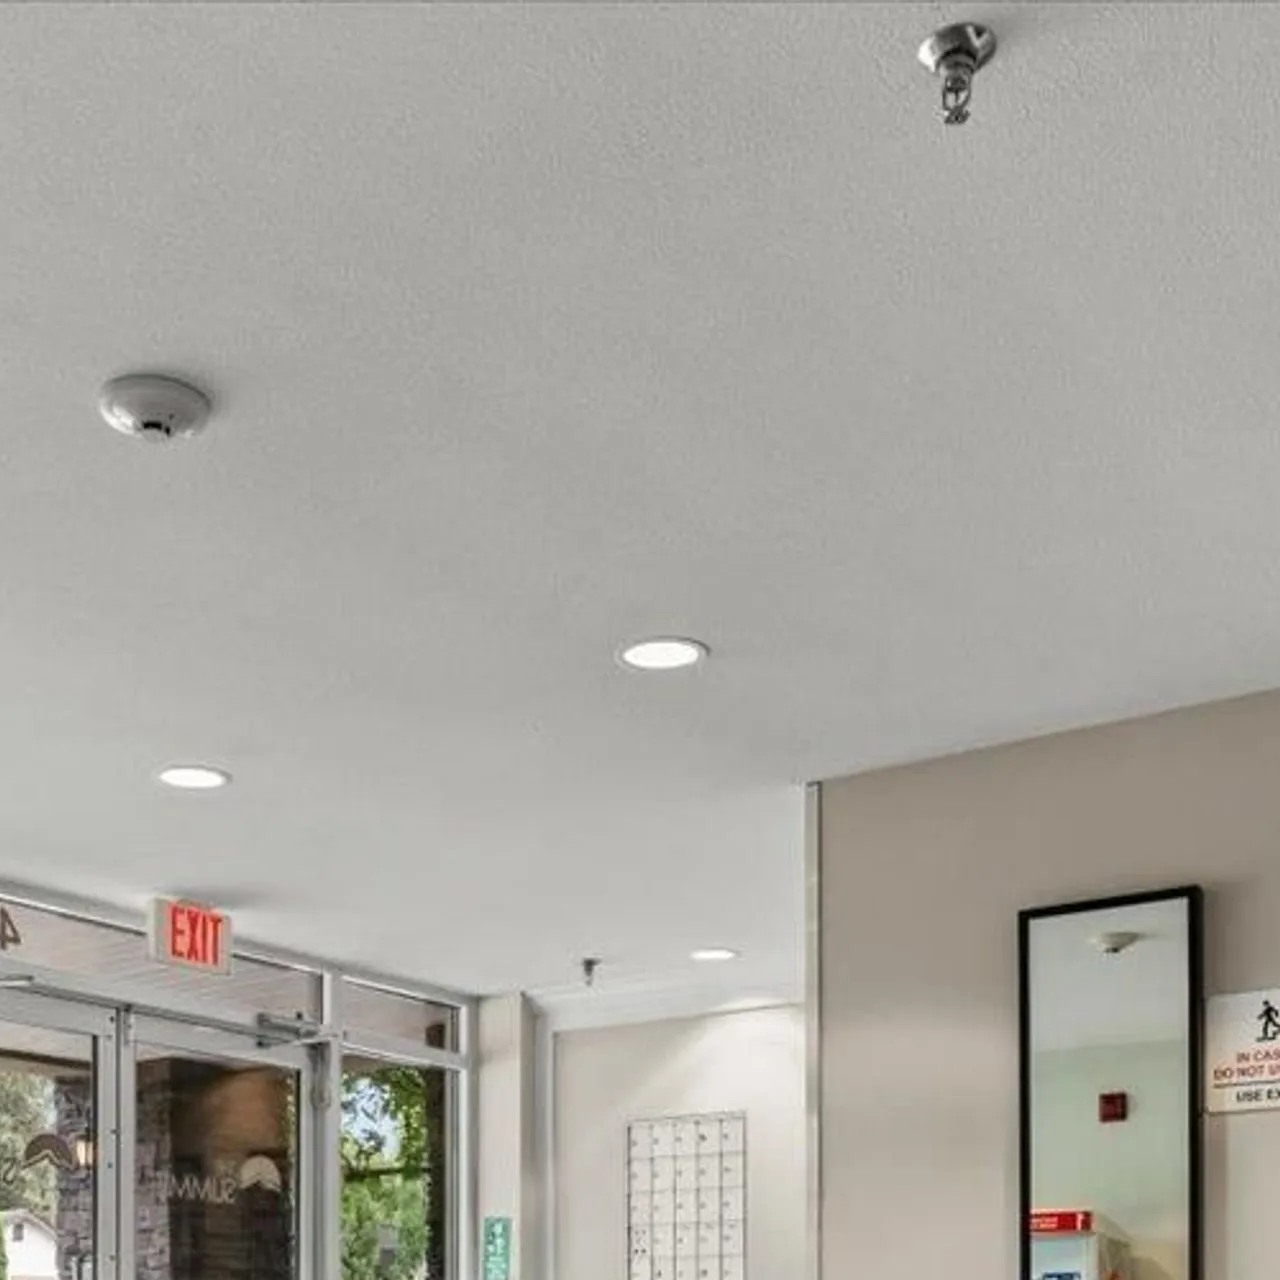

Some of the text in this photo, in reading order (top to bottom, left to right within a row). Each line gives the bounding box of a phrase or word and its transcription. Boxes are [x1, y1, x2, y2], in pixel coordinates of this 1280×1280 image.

[171, 905, 223, 967] EXIT
[1236, 1051, 1251, 1063] IN
[1213, 1068, 1234, 1081] DO
[1237, 1065, 1265, 1078] NOT
[1236, 1089, 1263, 1102] USE
